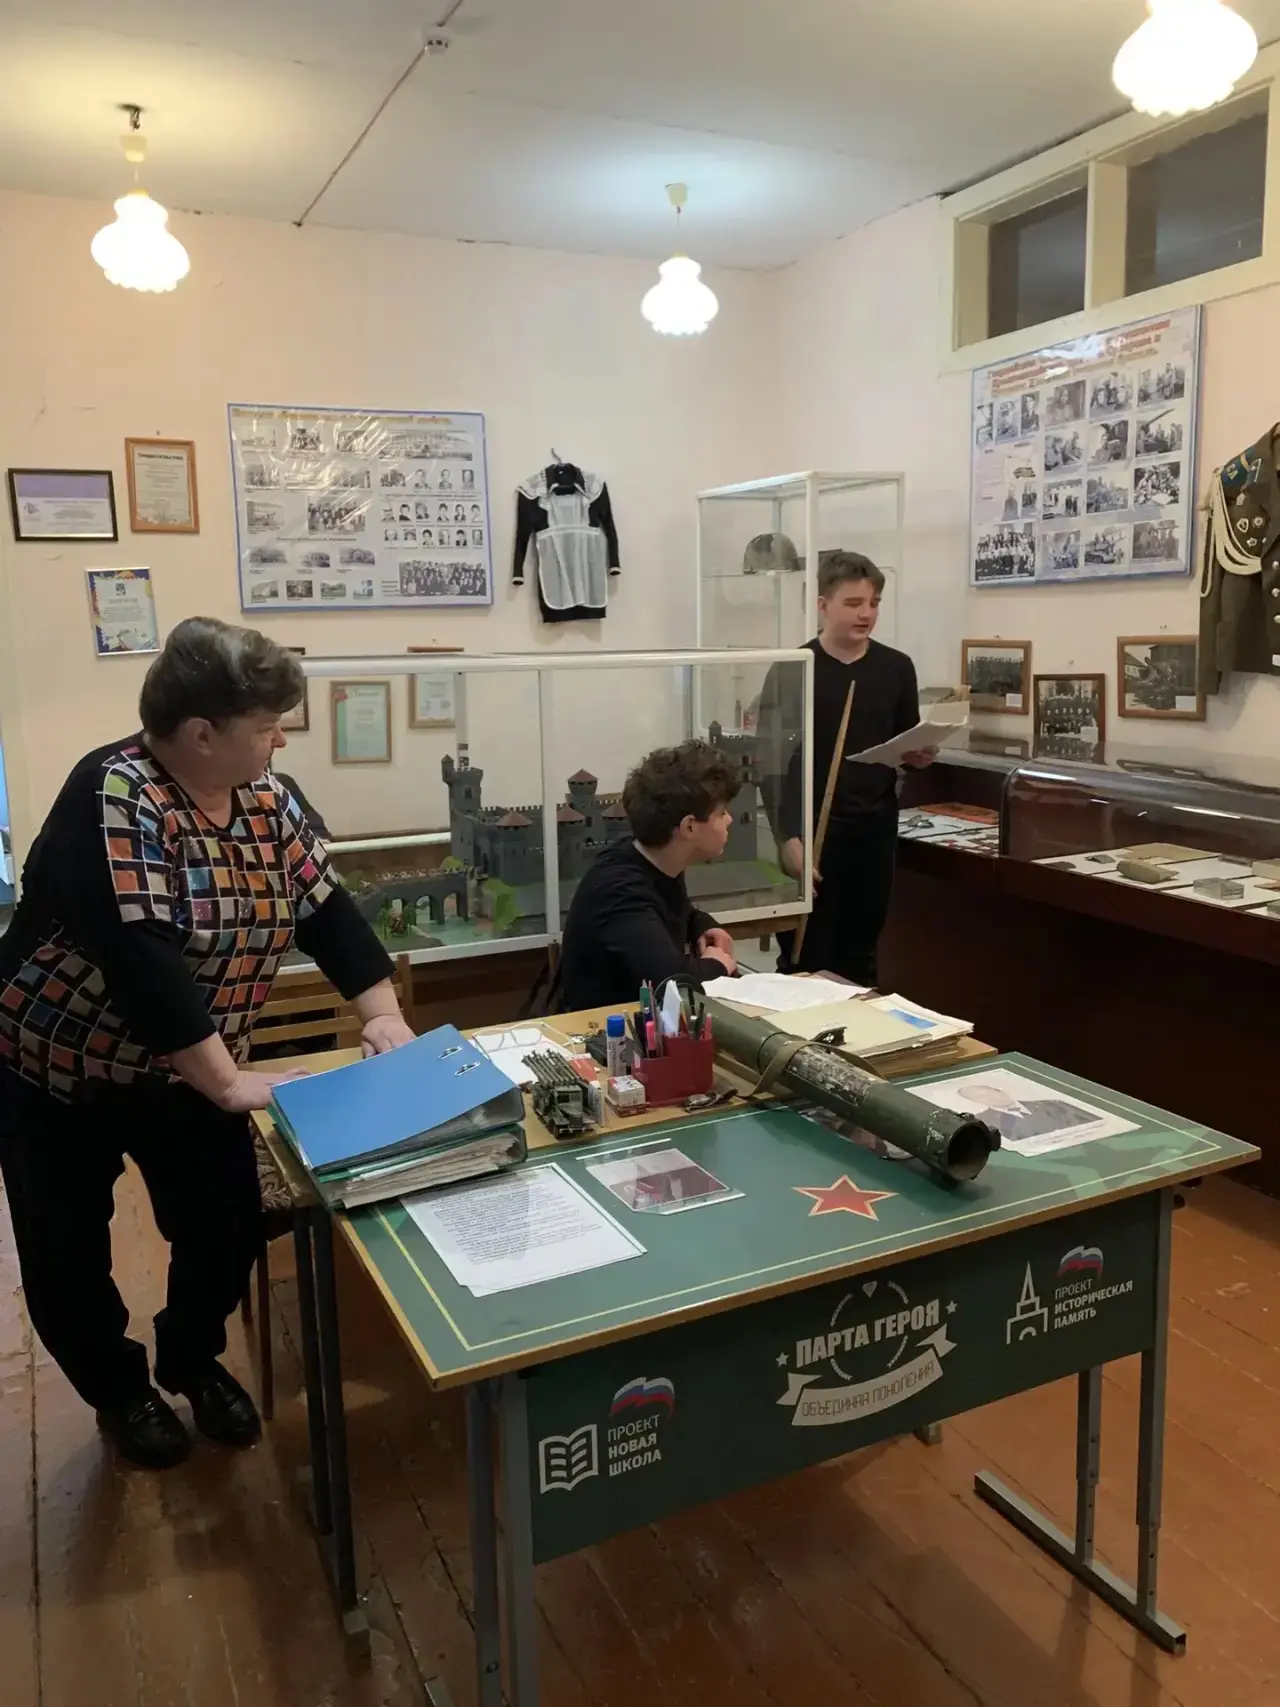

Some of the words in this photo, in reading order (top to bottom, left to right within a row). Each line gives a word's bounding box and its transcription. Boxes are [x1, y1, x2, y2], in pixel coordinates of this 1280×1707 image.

[1054, 1280, 1133, 1315] ИСТОРИЧЕСКАЯ
[1055, 1278, 1093, 1300] ПРОЕКТ
[1054, 1307, 1097, 1330] ПАМЯТЬ
[796, 1323, 870, 1368] ПАРТА
[874, 1298, 940, 1342] ГЕРОЯ
[607, 1413, 660, 1442] ПРОЕКТ
[608, 1432, 657, 1460] НОВАЯ
[608, 1448, 662, 1476] ШКОЛА
